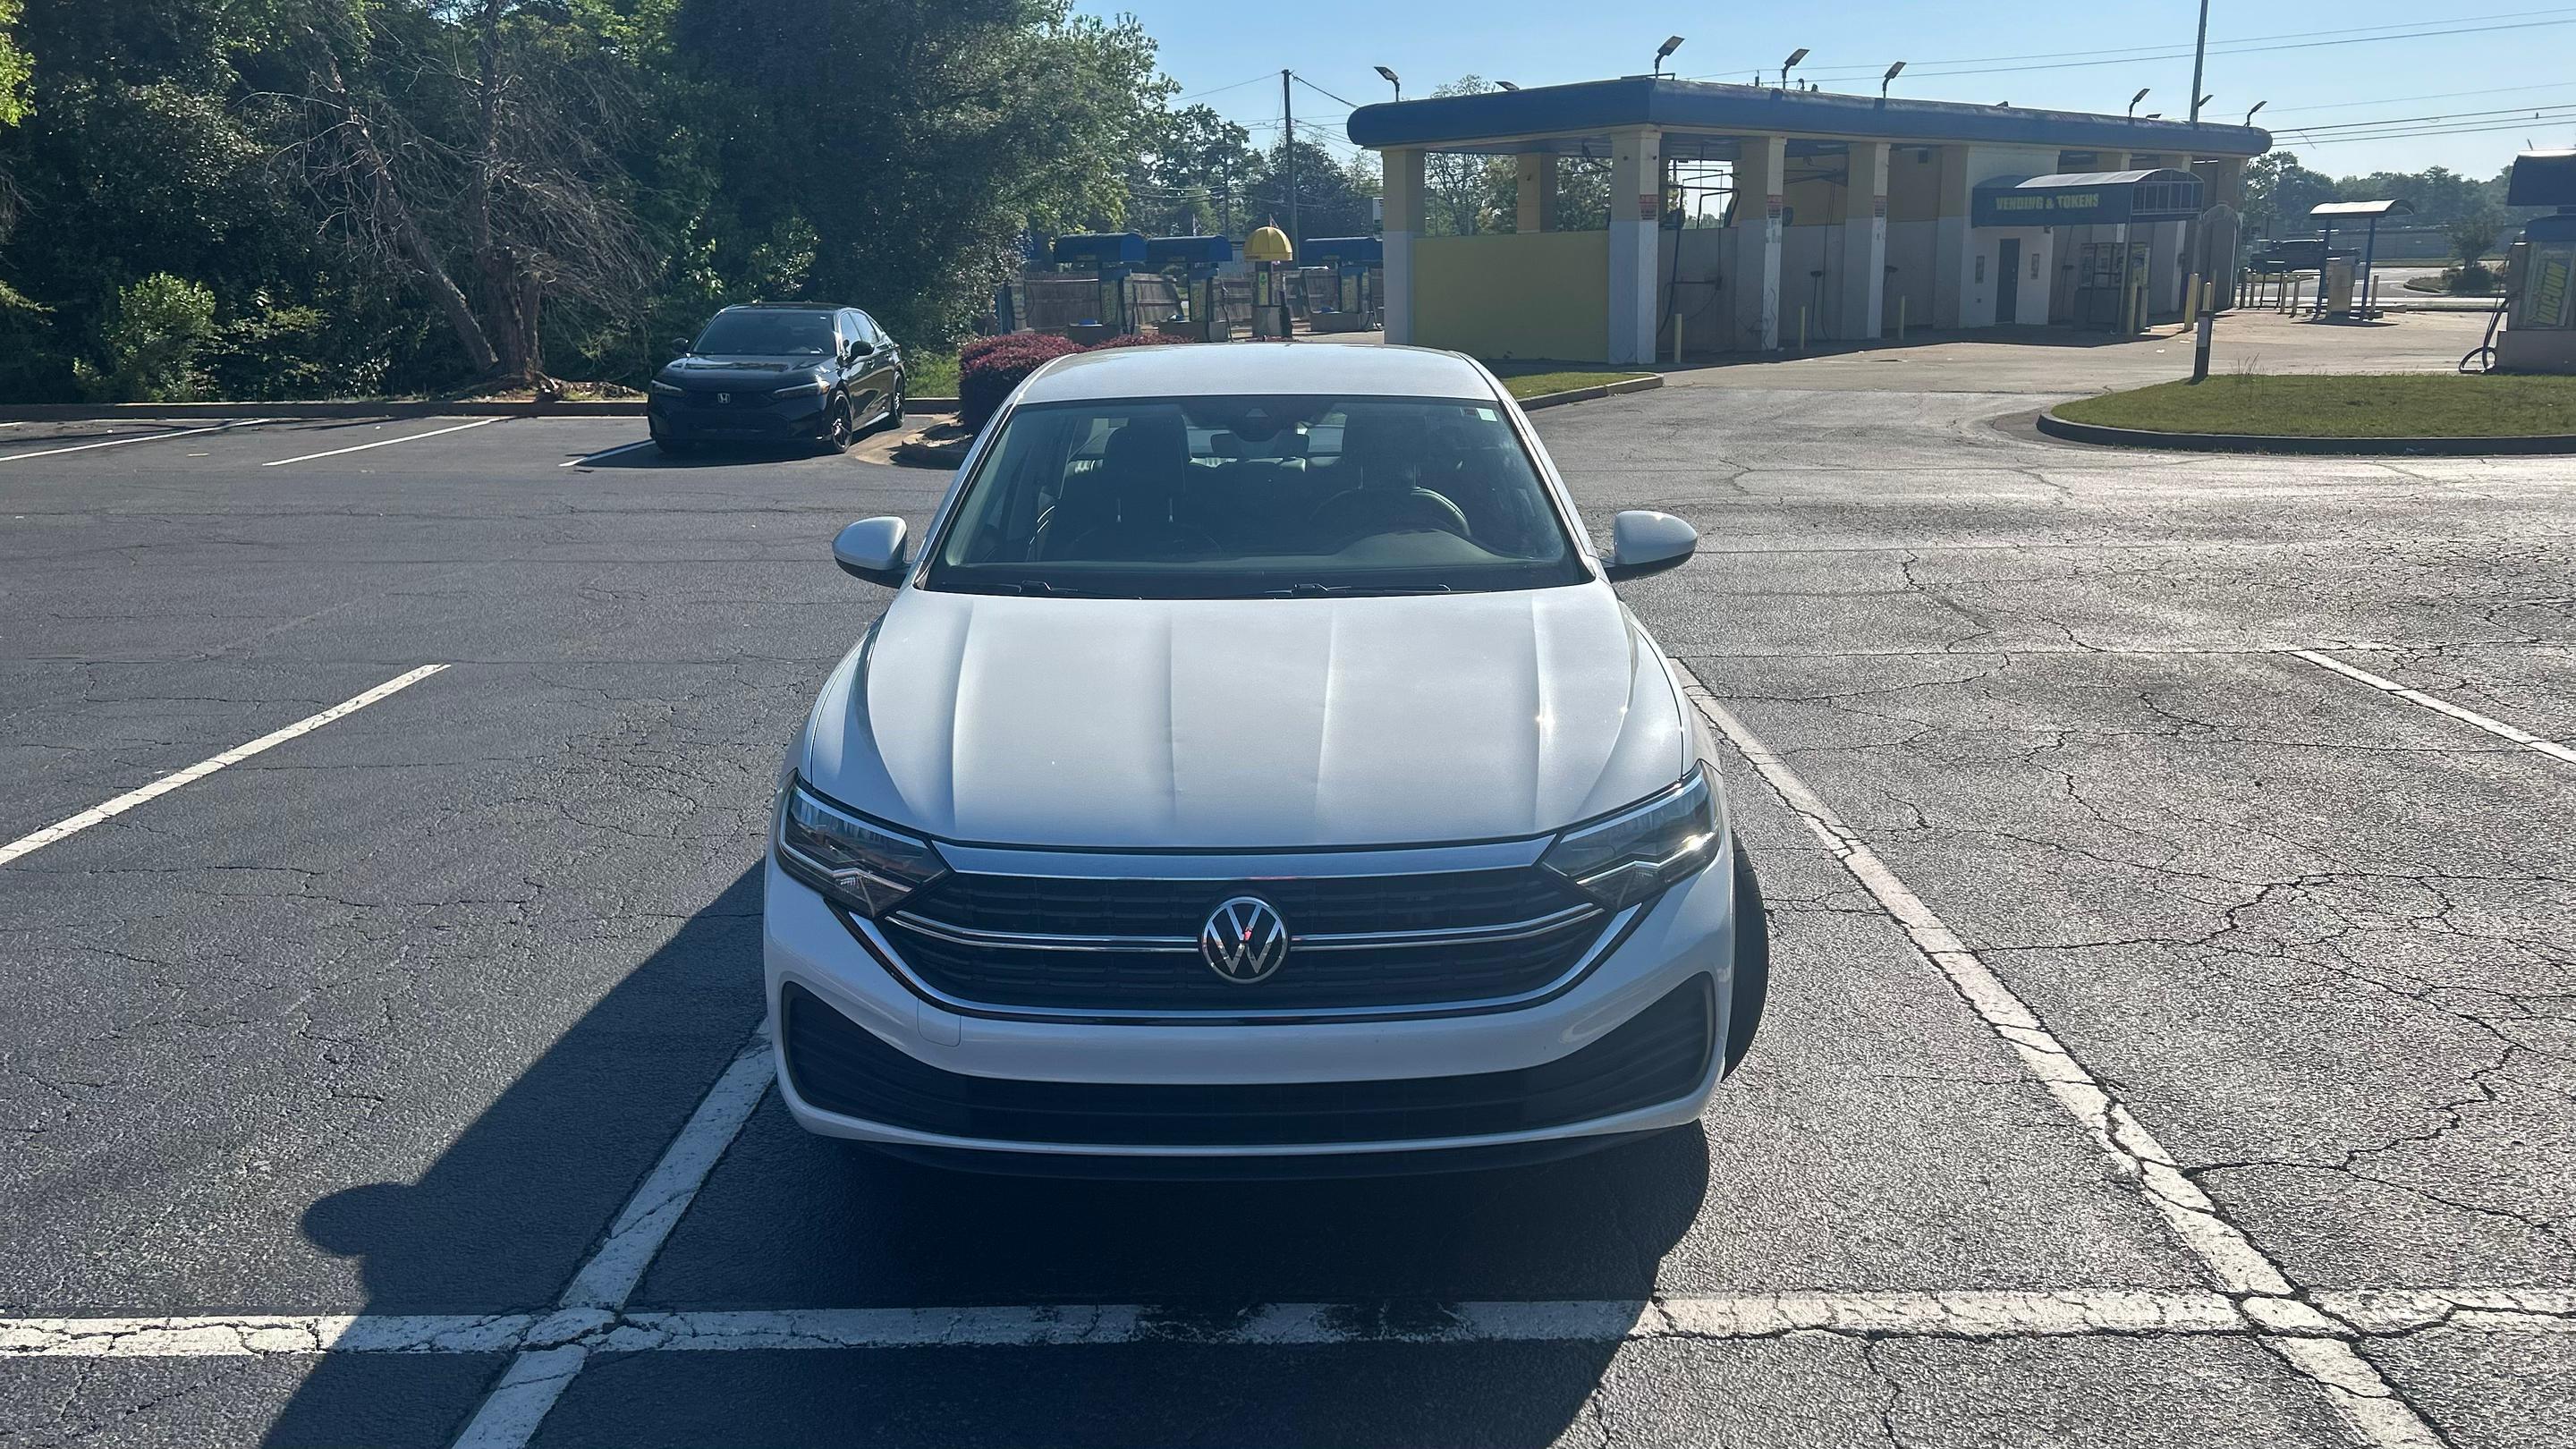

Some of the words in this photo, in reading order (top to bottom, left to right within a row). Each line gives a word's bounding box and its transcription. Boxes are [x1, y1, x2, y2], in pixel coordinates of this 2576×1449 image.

[1996, 196, 2044, 210] VENDING
[2046, 198, 2054, 209] &
[2056, 192, 2099, 208] TOKENS
[1204, 899, 1285, 980] VW
